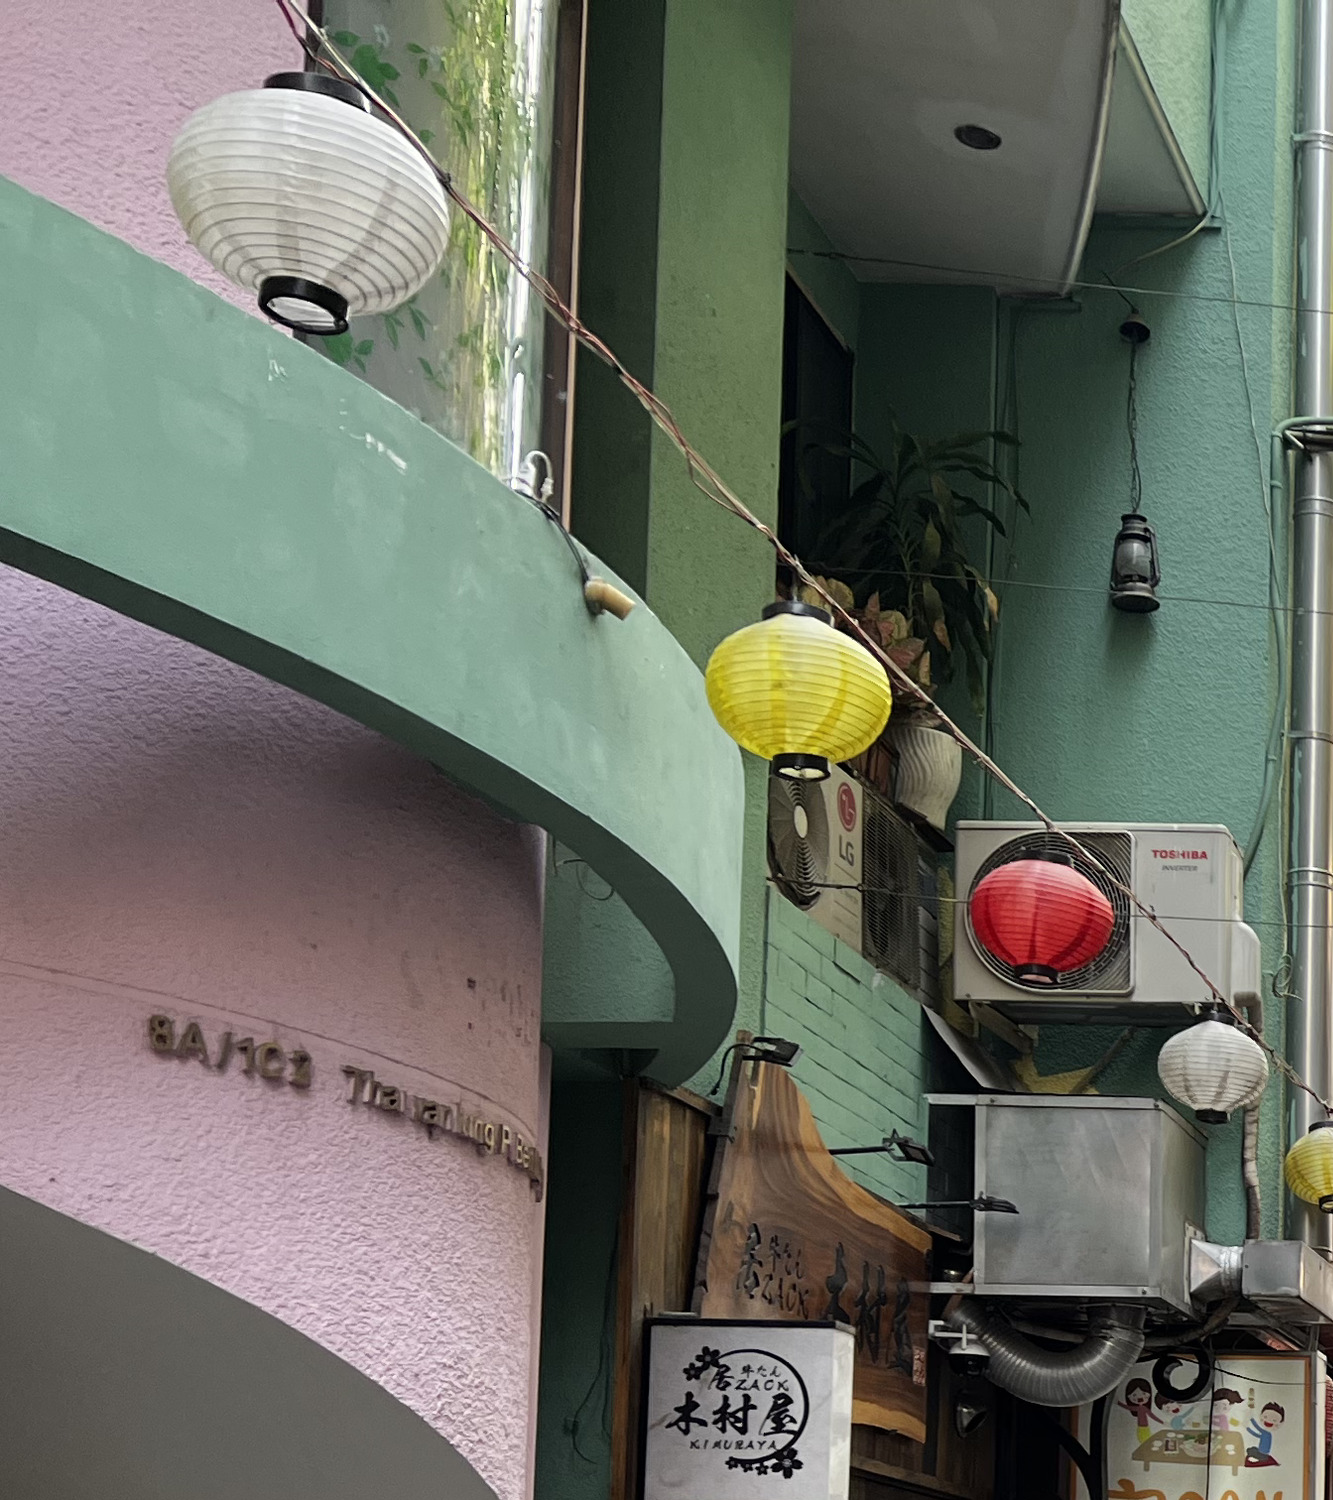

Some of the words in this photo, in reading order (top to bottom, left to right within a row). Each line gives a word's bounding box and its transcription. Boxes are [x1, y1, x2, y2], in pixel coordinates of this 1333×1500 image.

[1151, 848, 1209, 861] TOSHIBA
[735, 1379, 790, 1392] ZACK
[665, 1391, 801, 1437] 木村屋
[689, 1439, 777, 1450] KIMURAYA
